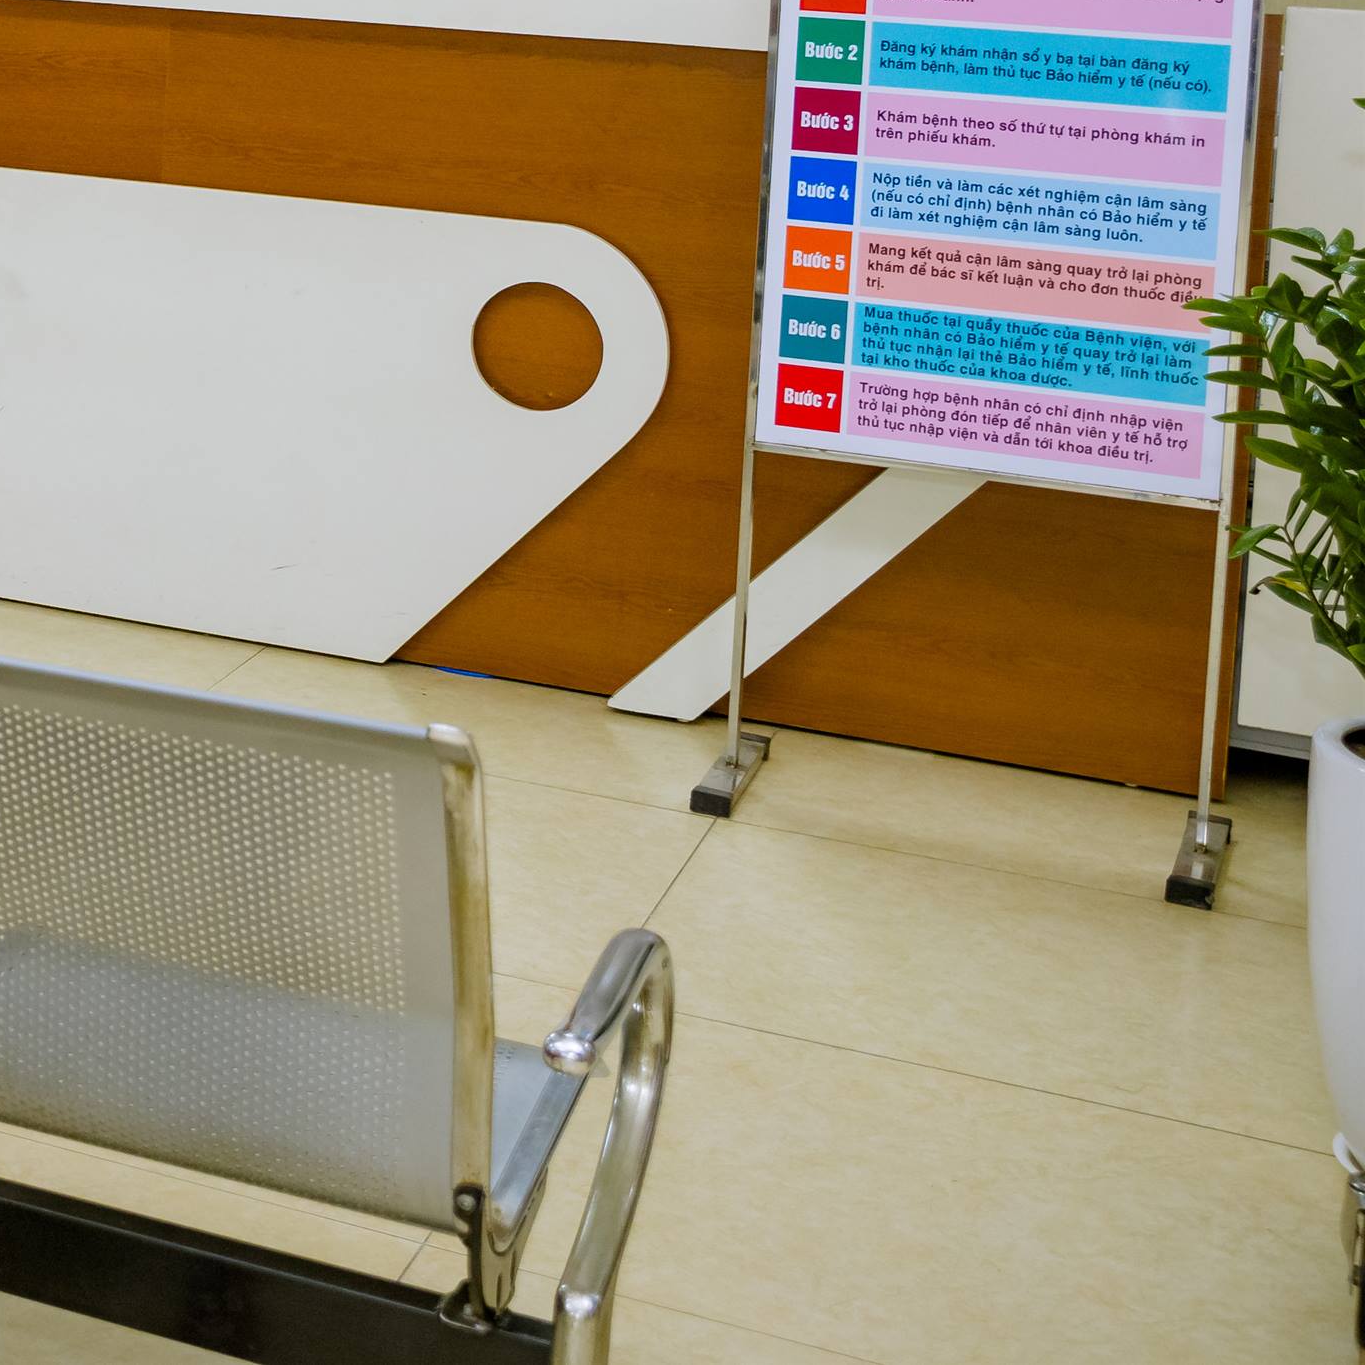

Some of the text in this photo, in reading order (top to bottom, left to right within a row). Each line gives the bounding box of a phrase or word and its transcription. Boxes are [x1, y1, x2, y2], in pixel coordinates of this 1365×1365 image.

[805, 41, 858, 61] Bước 2
[801, 111, 854, 131] Bước 3
[876, 109, 1206, 148] Khám bệnh theo số thứ tự tại phòng khám in
[875, 126, 996, 148] trên phiếu khám.
[797, 180, 849, 201] Bước 4
[792, 249, 845, 271] Bước 5
[788, 318, 841, 340] Bước 6
[784, 387, 836, 410] Bước 7
[858, 381, 1183, 433] Trường hợp bệnh nhân có chỉ định nhập viện
[858, 397, 1189, 452] trở lại phòng đón tiếp để nhân viên y tế hỗ trợ
